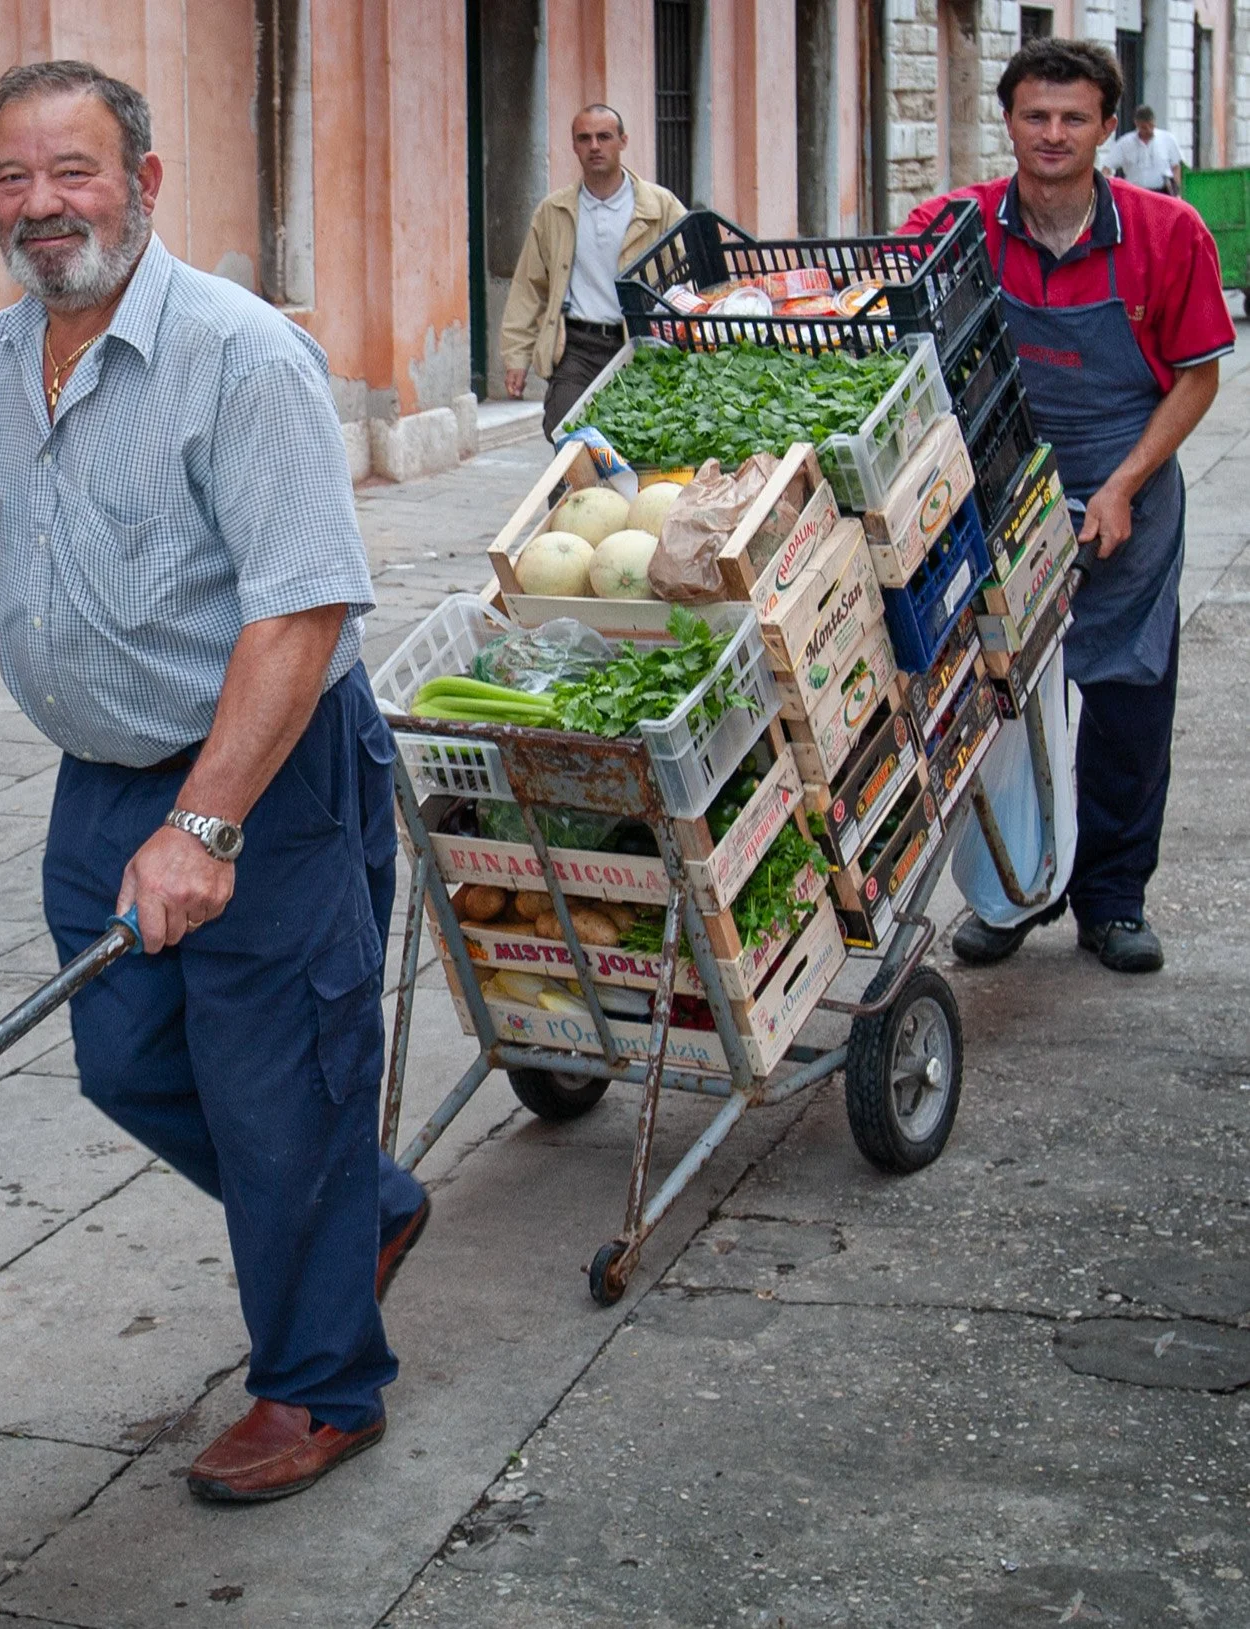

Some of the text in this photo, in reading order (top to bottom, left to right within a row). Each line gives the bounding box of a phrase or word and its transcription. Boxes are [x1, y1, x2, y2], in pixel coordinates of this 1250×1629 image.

[778, 521, 817, 580] NADALINI
[806, 581, 863, 665] MonteSan
[597, 952, 662, 979] JOLL
